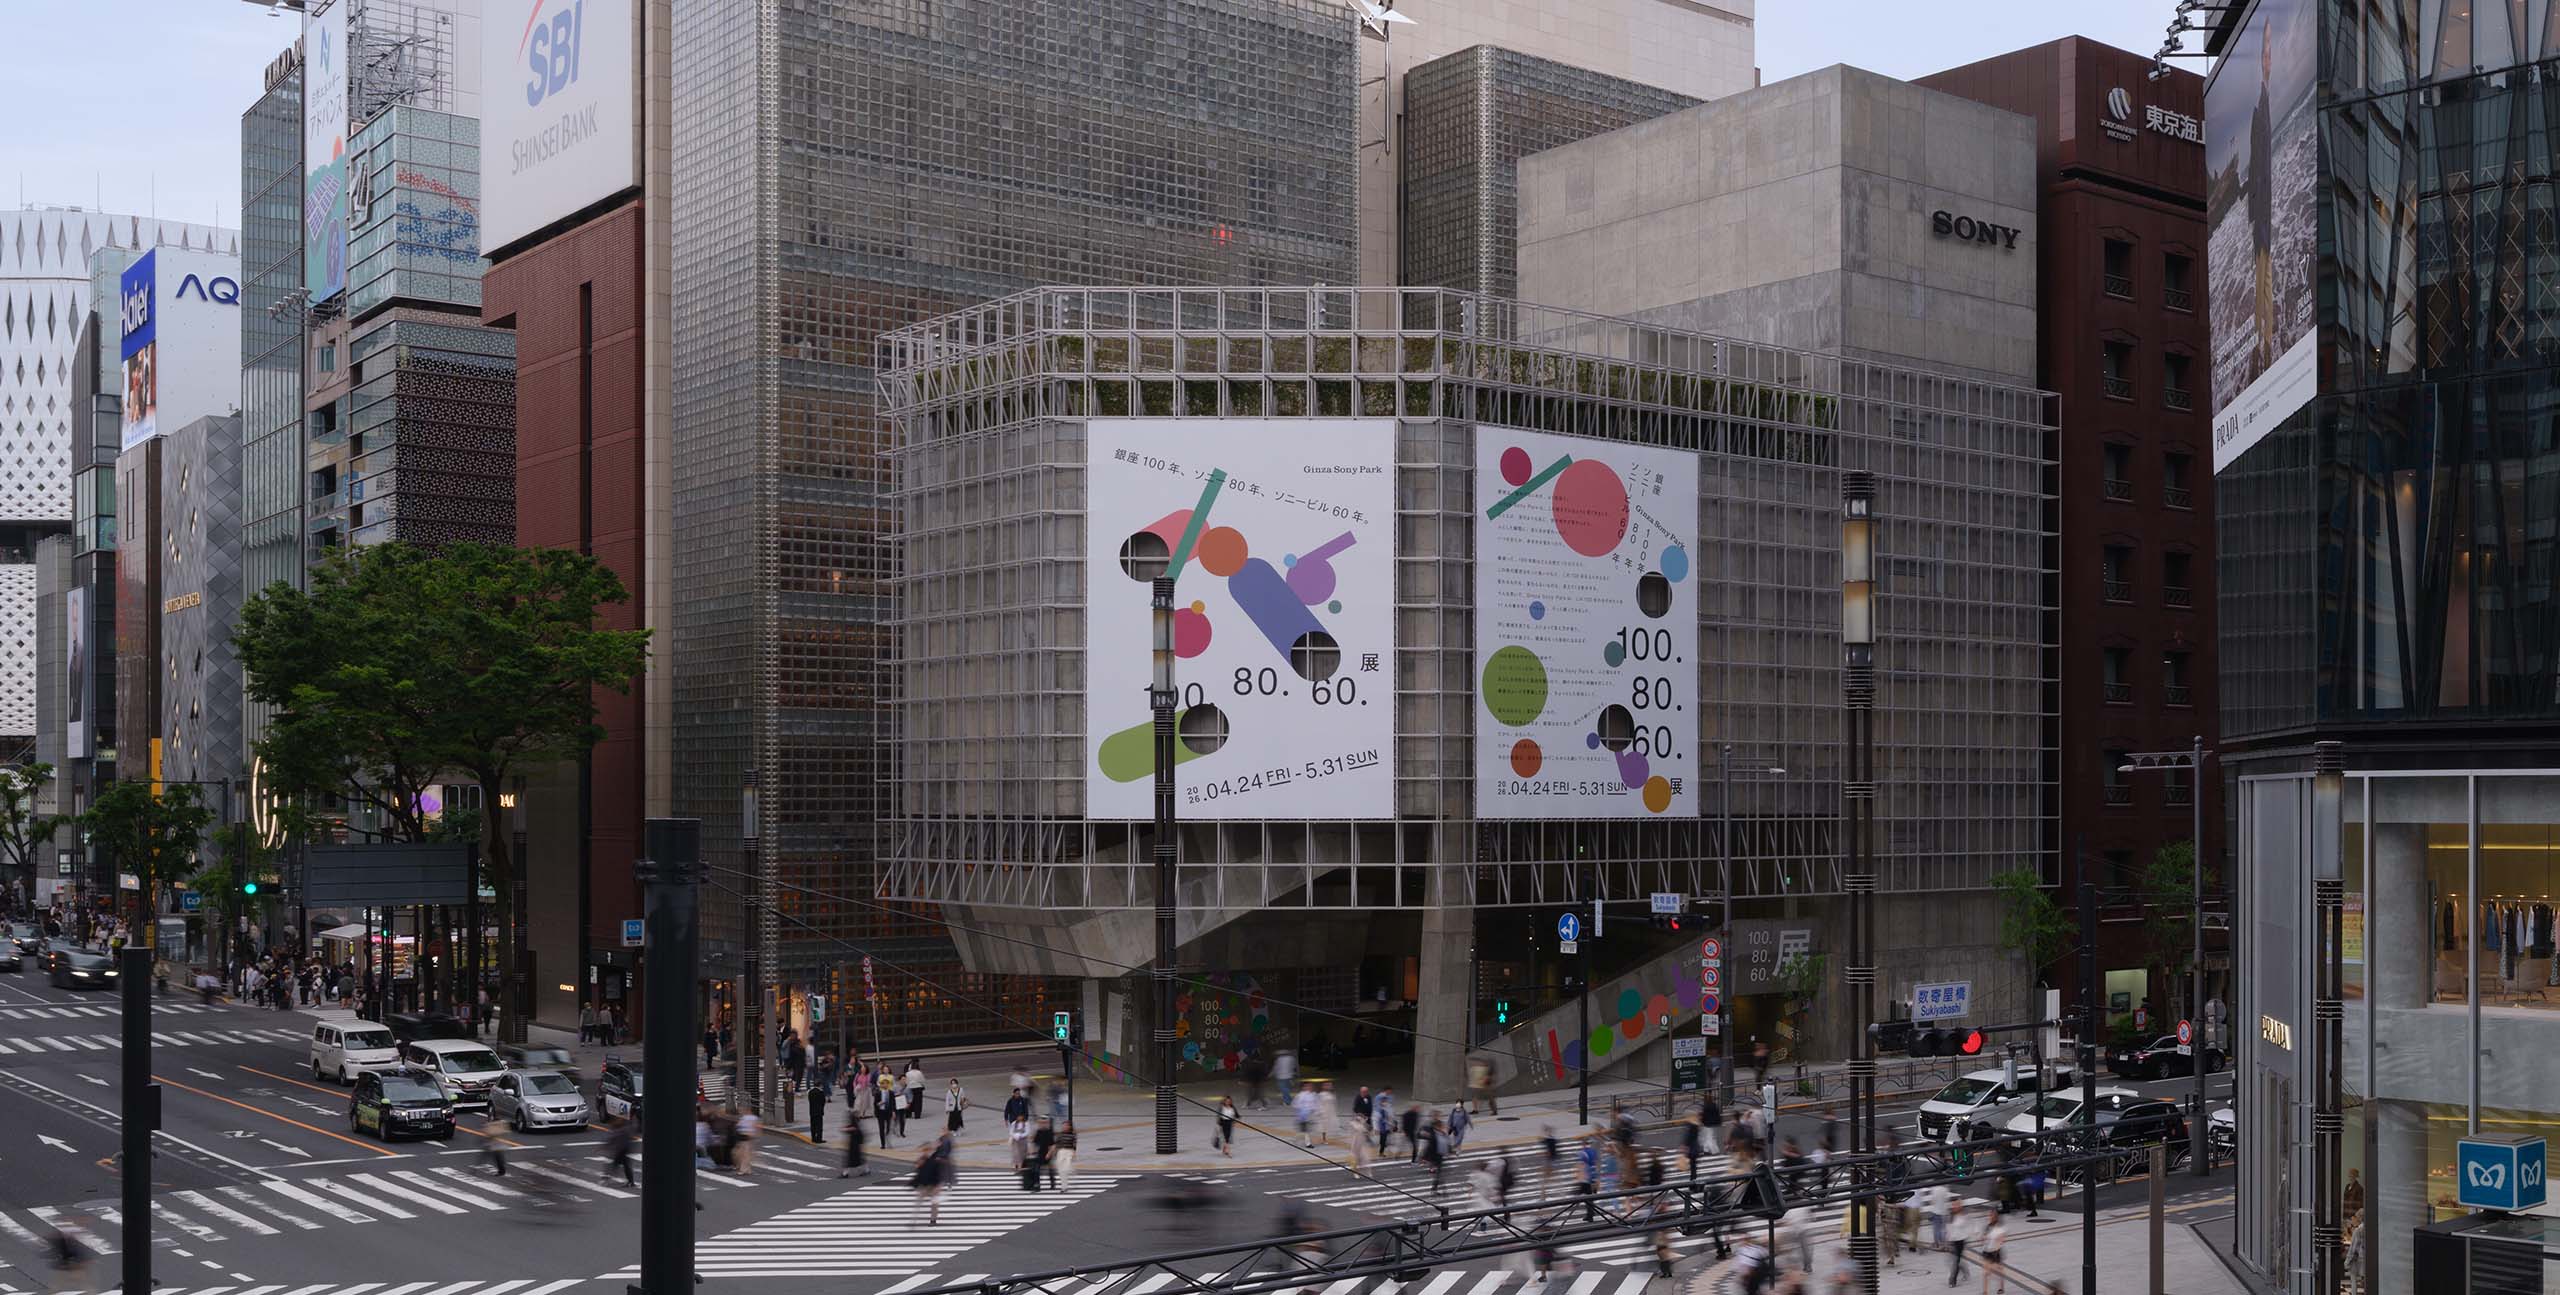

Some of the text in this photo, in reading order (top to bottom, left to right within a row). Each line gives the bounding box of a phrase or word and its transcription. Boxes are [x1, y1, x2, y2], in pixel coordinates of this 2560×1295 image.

[527, 0, 582, 107] SBI
[512, 101, 598, 176] SHINSEI BANK
[1933, 210, 2022, 249] SONY
[120, 280, 149, 336] Haier
[2216, 413, 2239, 451] PRADA
[1303, 464, 1383, 476] Ginza Sony Park
[1635, 504, 1686, 550] Ginza Sony Park
[1617, 626, 1682, 662] 100.
[1360, 653, 1379, 672] 展
[1234, 667, 1289, 697] 80.
[1311, 677, 1367, 706] 60.
[1632, 676, 1682, 712] 80.
[1632, 725, 1682, 760] 60.
[1346, 749, 1378, 766] SUN
[1552, 781, 1570, 791] FRI
[1747, 930, 1773, 945] 100.
[1751, 949, 1771, 963] 80.
[1750, 968, 1769, 982] 60.
[1200, 1000, 1222, 1012] 100.
[1918, 986, 1966, 1003] 数寄屋橋
[1204, 1014, 1222, 1025] 80.
[1920, 1002, 1961, 1017] Sukiyabashi
[2261, 1015, 2292, 1051] PRADA
